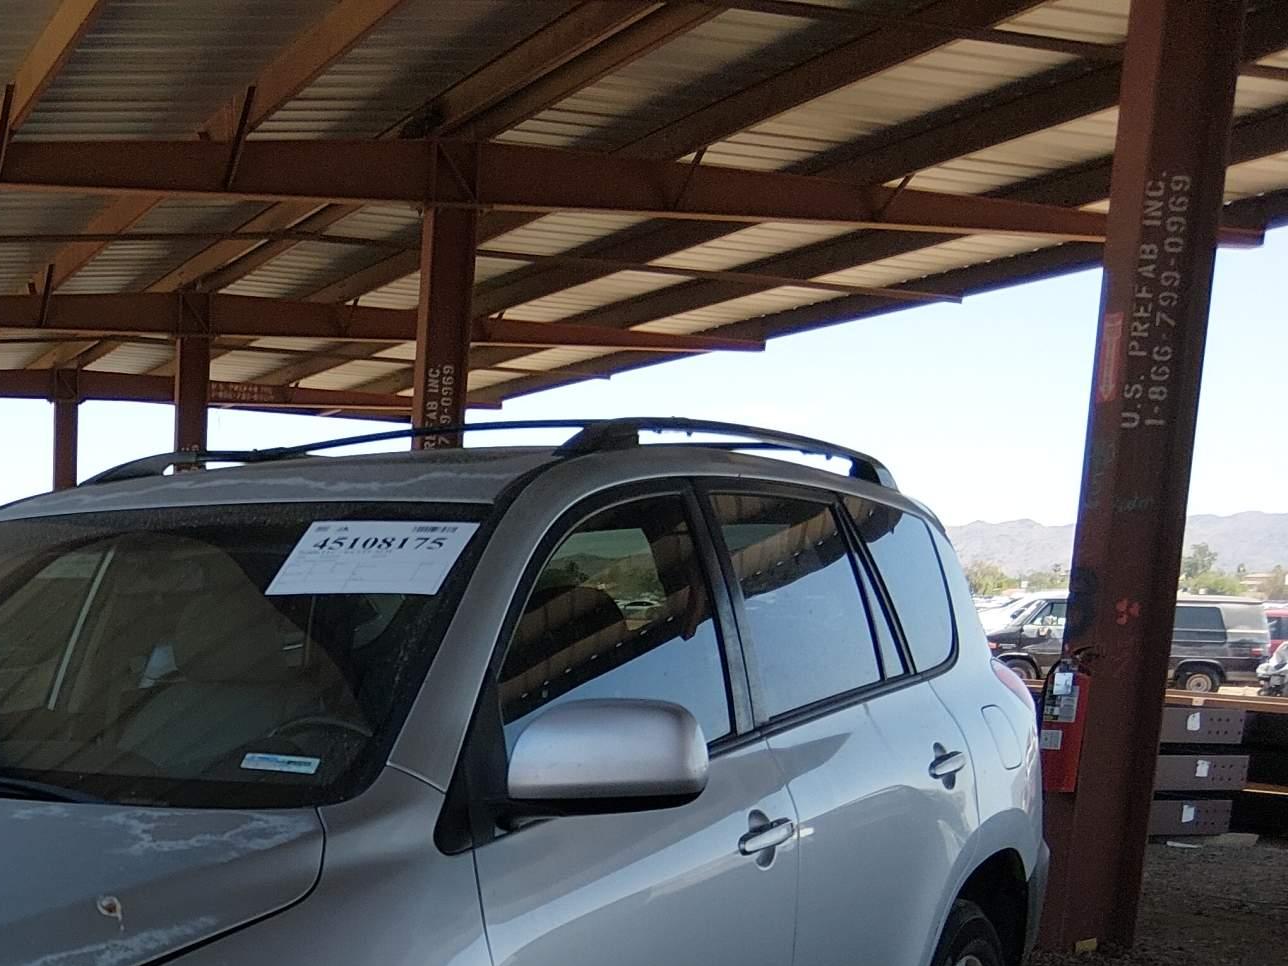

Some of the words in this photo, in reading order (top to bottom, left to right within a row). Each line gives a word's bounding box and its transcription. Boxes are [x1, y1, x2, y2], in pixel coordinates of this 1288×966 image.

[1143, 170, 1167, 226] INC.
[1128, 243, 1159, 357] PREFAB
[1144, 175, 1191, 426] 1-866-799-0969
[1120, 374, 1144, 428] U.S.
[313, 536, 448, 551] 45108175
